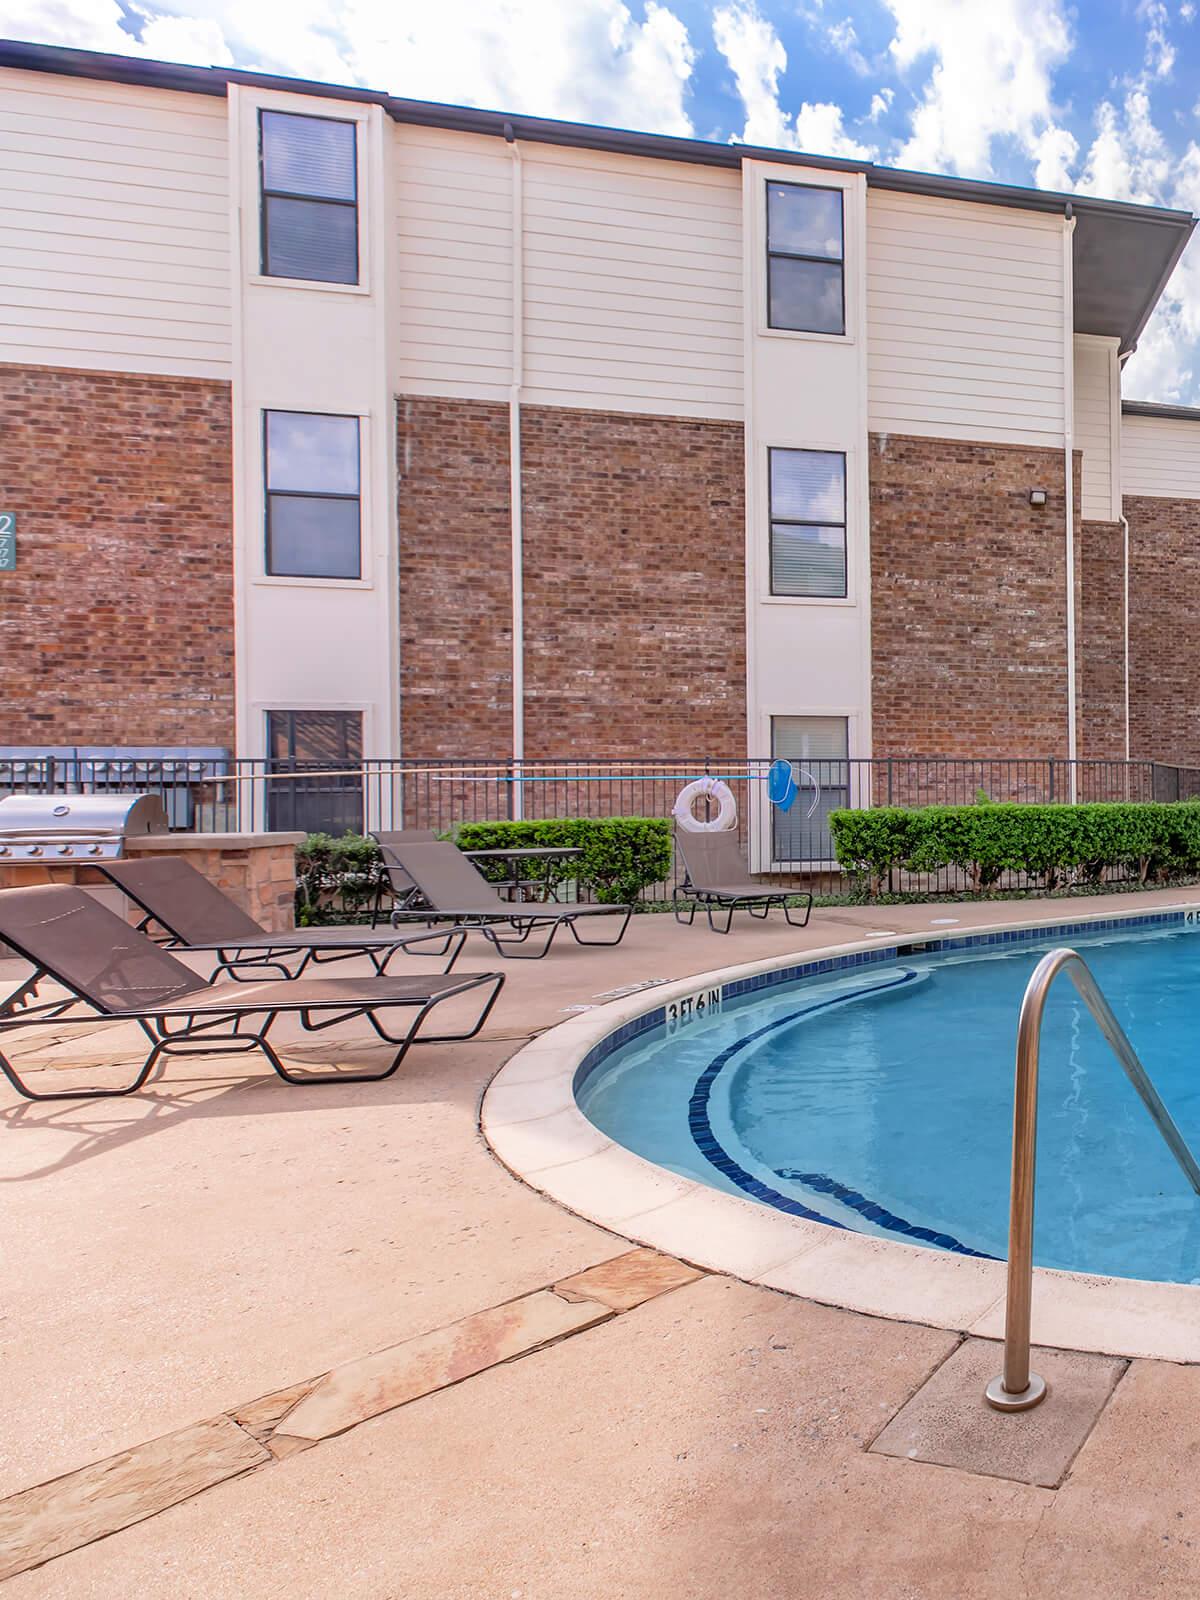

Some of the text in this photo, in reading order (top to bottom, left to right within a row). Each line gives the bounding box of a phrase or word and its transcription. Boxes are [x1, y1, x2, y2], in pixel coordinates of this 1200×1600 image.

[669, 989, 720, 1019] 3 FT 6 IN
